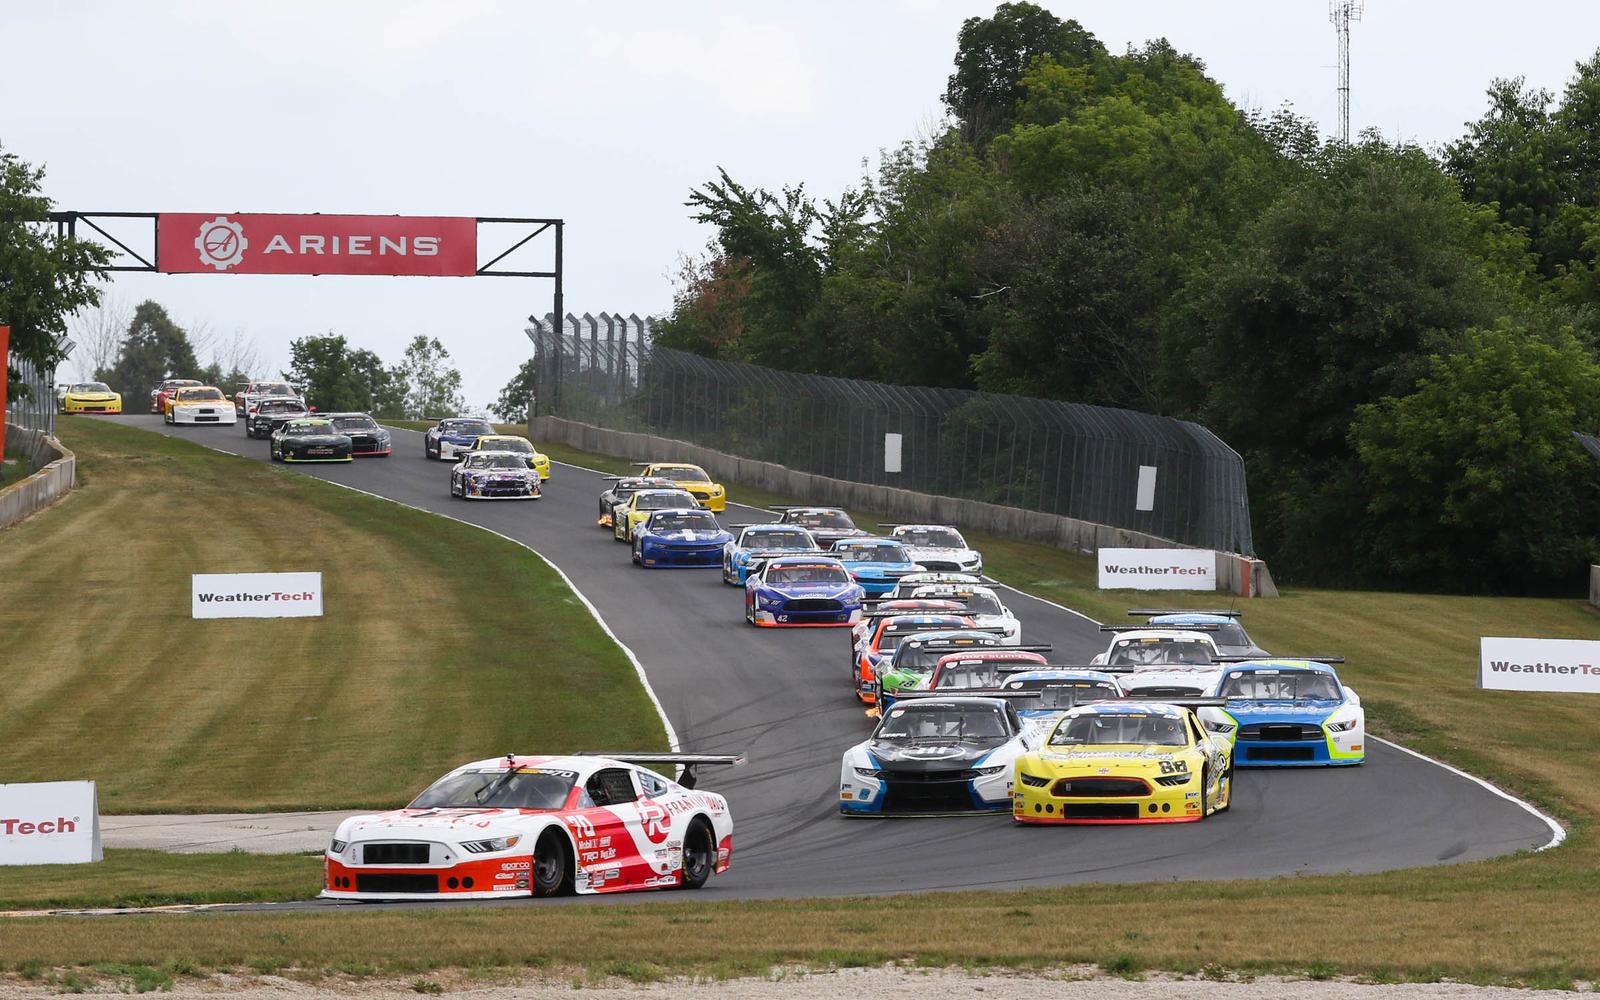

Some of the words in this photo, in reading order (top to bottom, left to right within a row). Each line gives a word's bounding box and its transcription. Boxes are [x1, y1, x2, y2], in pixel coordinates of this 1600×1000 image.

[263, 234, 439, 256] ARIENS
[1105, 565, 1207, 576] WeatherTech
[198, 592, 313, 602] WeatherTech
[1490, 661, 1600, 675] WeatherTe
[0, 817, 75, 835] Tech
[566, 815, 596, 838] 70
[578, 839, 593, 850] Mobil
[501, 861, 530, 871] sparco
